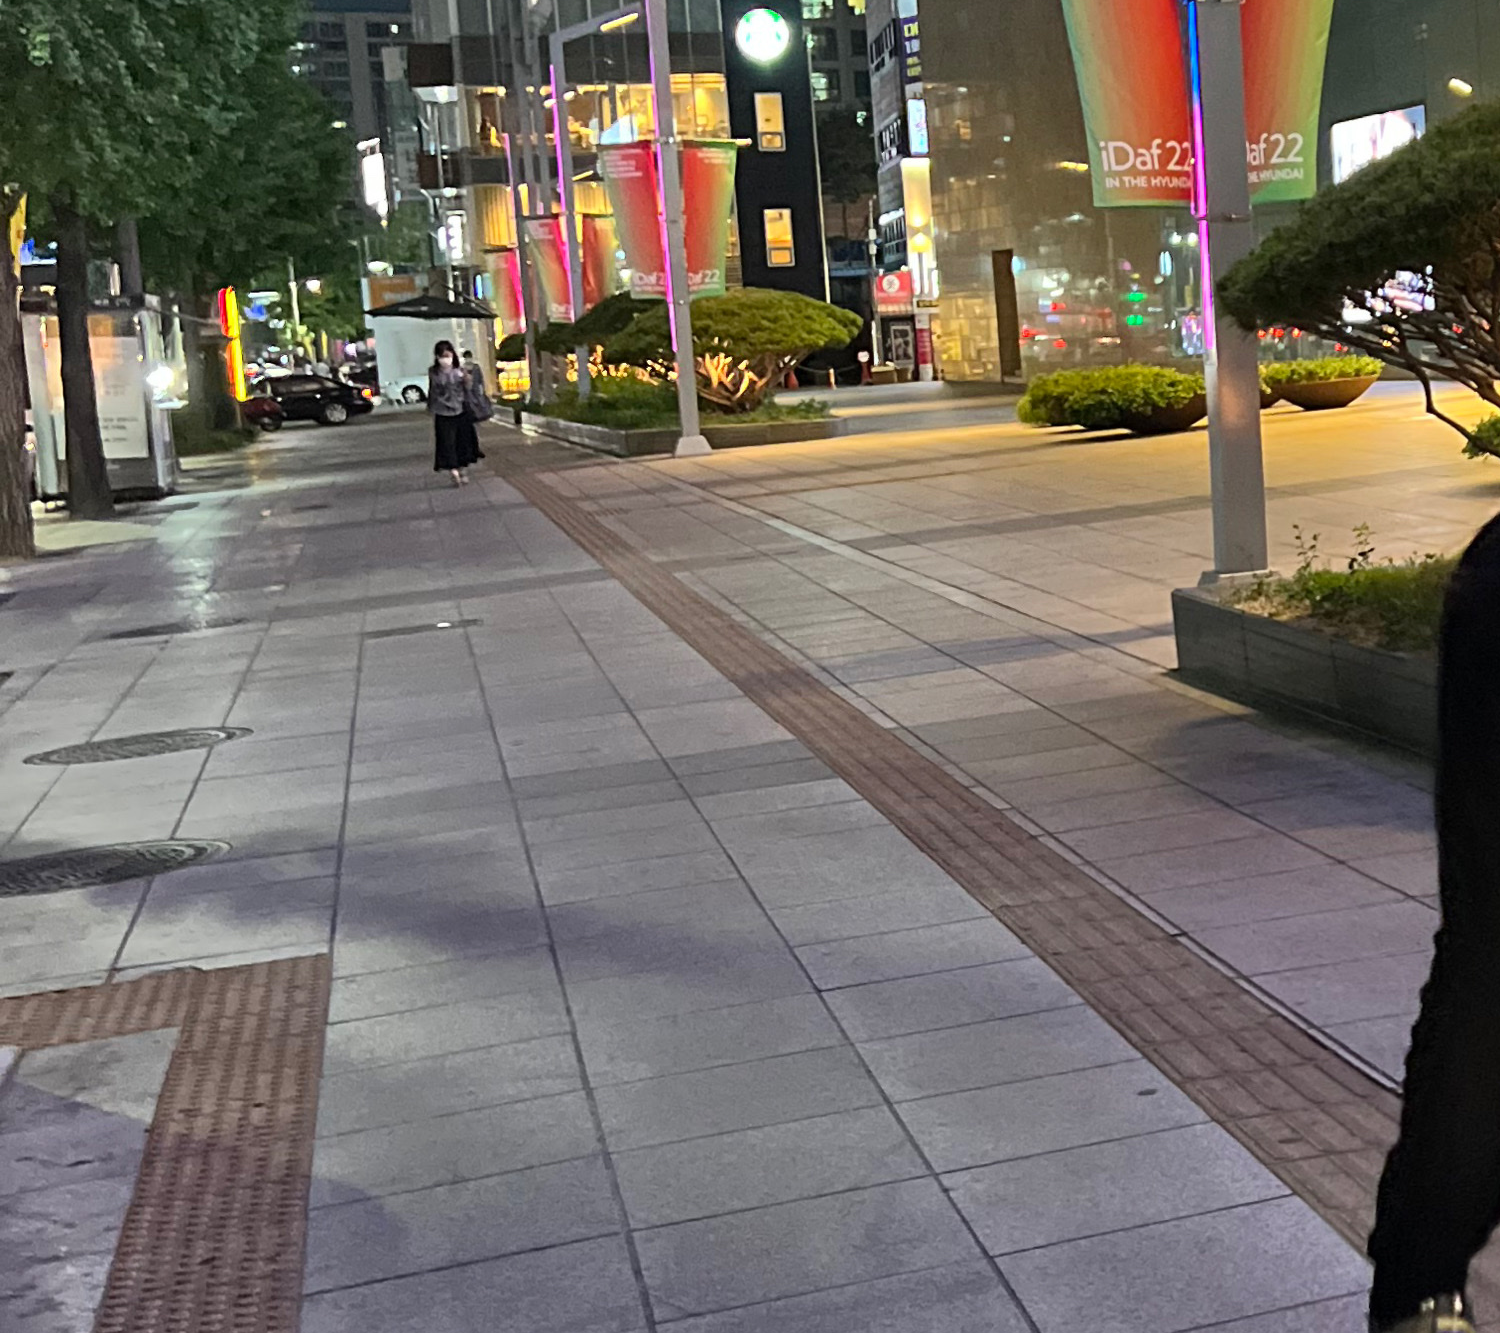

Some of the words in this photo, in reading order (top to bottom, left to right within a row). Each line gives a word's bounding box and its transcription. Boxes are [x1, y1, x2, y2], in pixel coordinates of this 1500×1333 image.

[1099, 138, 1162, 172] iDaf
[1270, 132, 1304, 165] 22
[1105, 176, 1120, 189] IN
[1123, 175, 1148, 188] THE
[1259, 168, 1304, 183] HYUNDAI
